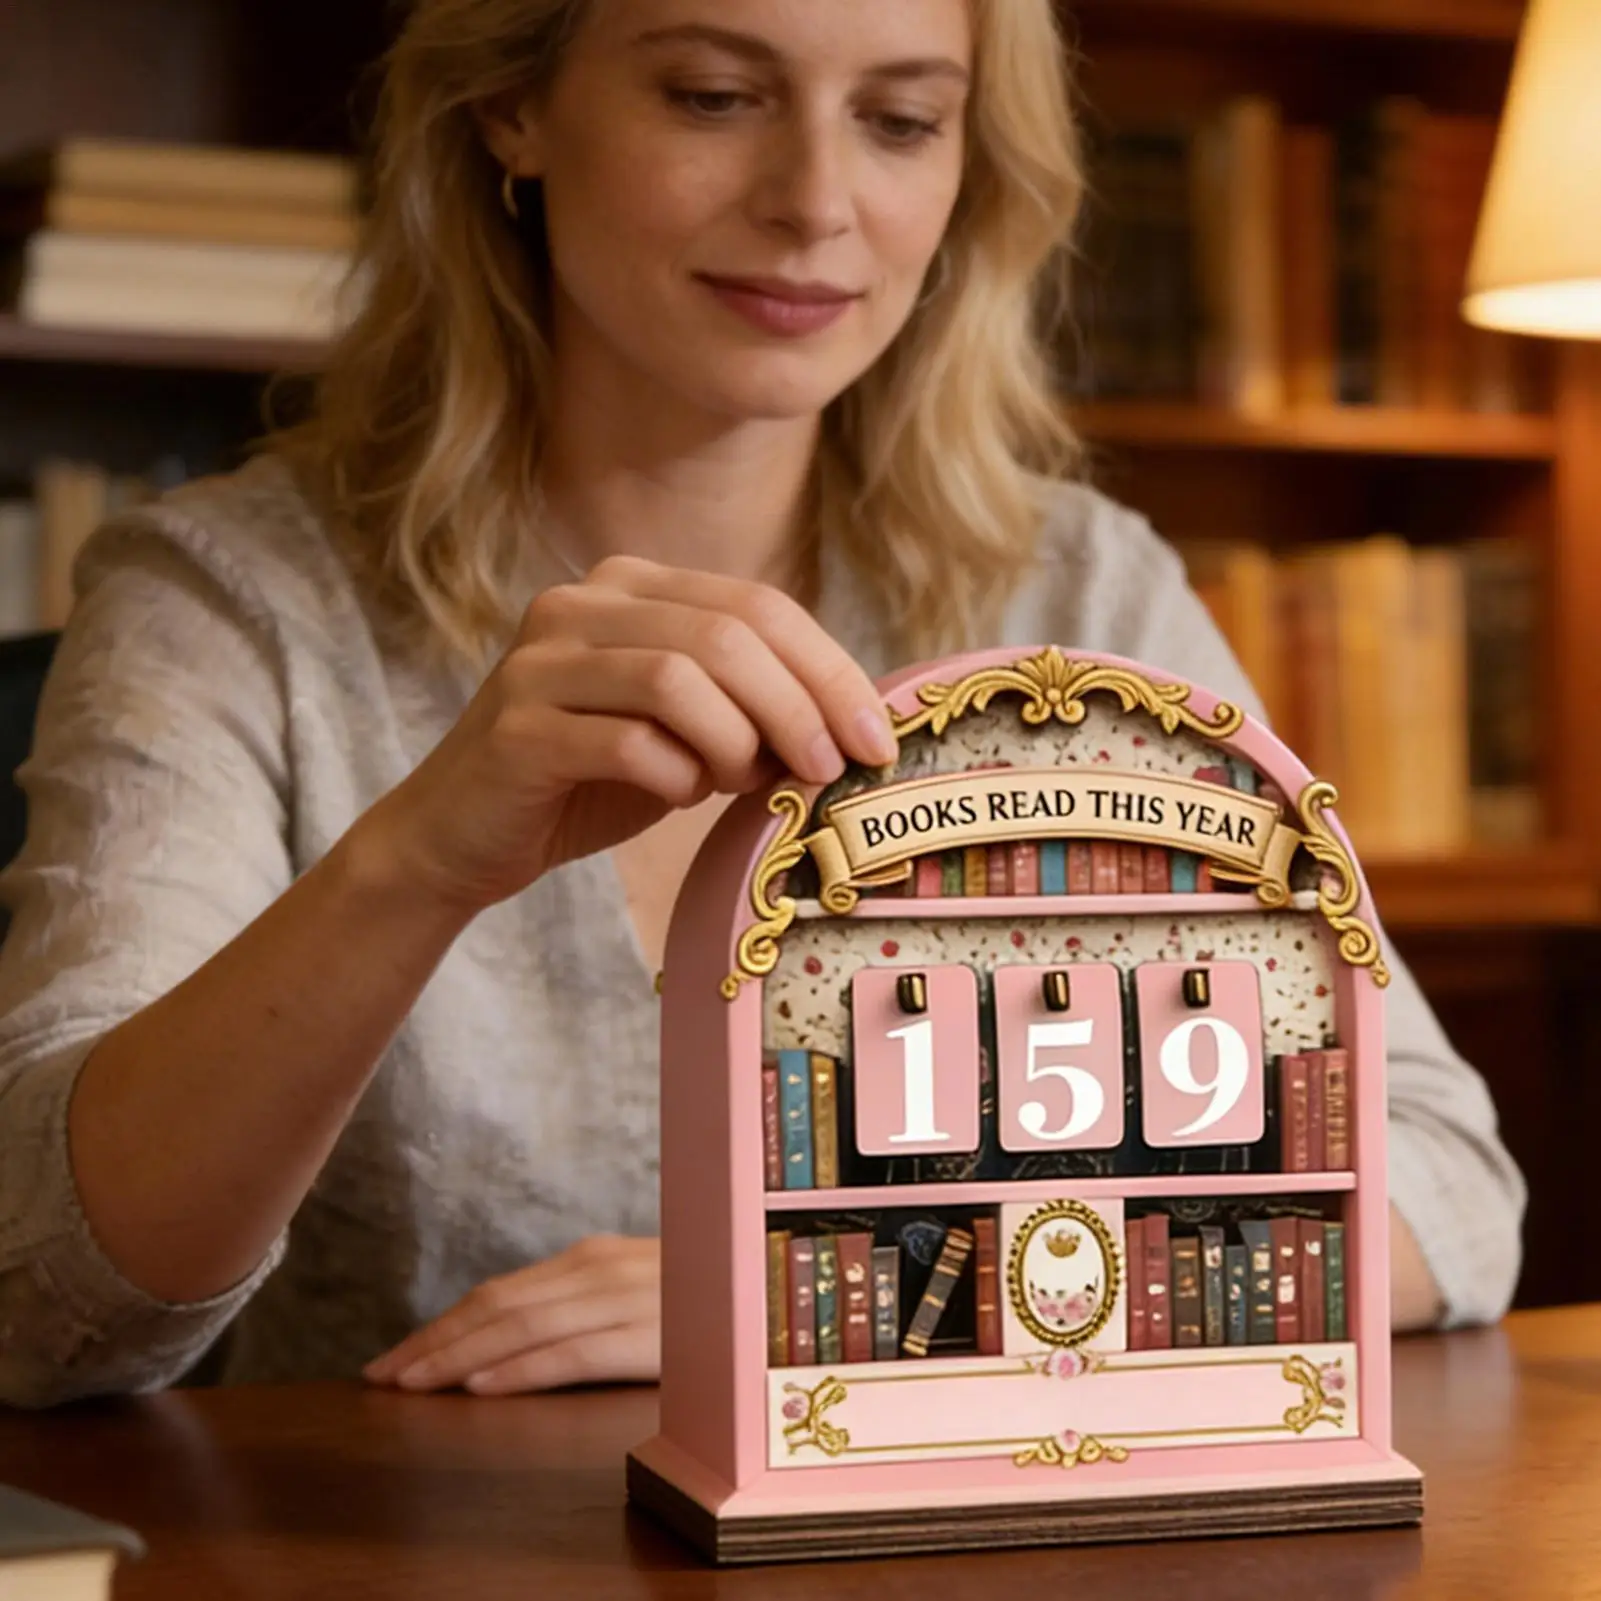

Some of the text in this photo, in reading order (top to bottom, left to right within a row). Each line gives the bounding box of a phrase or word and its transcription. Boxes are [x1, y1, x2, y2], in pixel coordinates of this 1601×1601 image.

[861, 789, 1255, 848] BOOKS READ THIS YEAR
